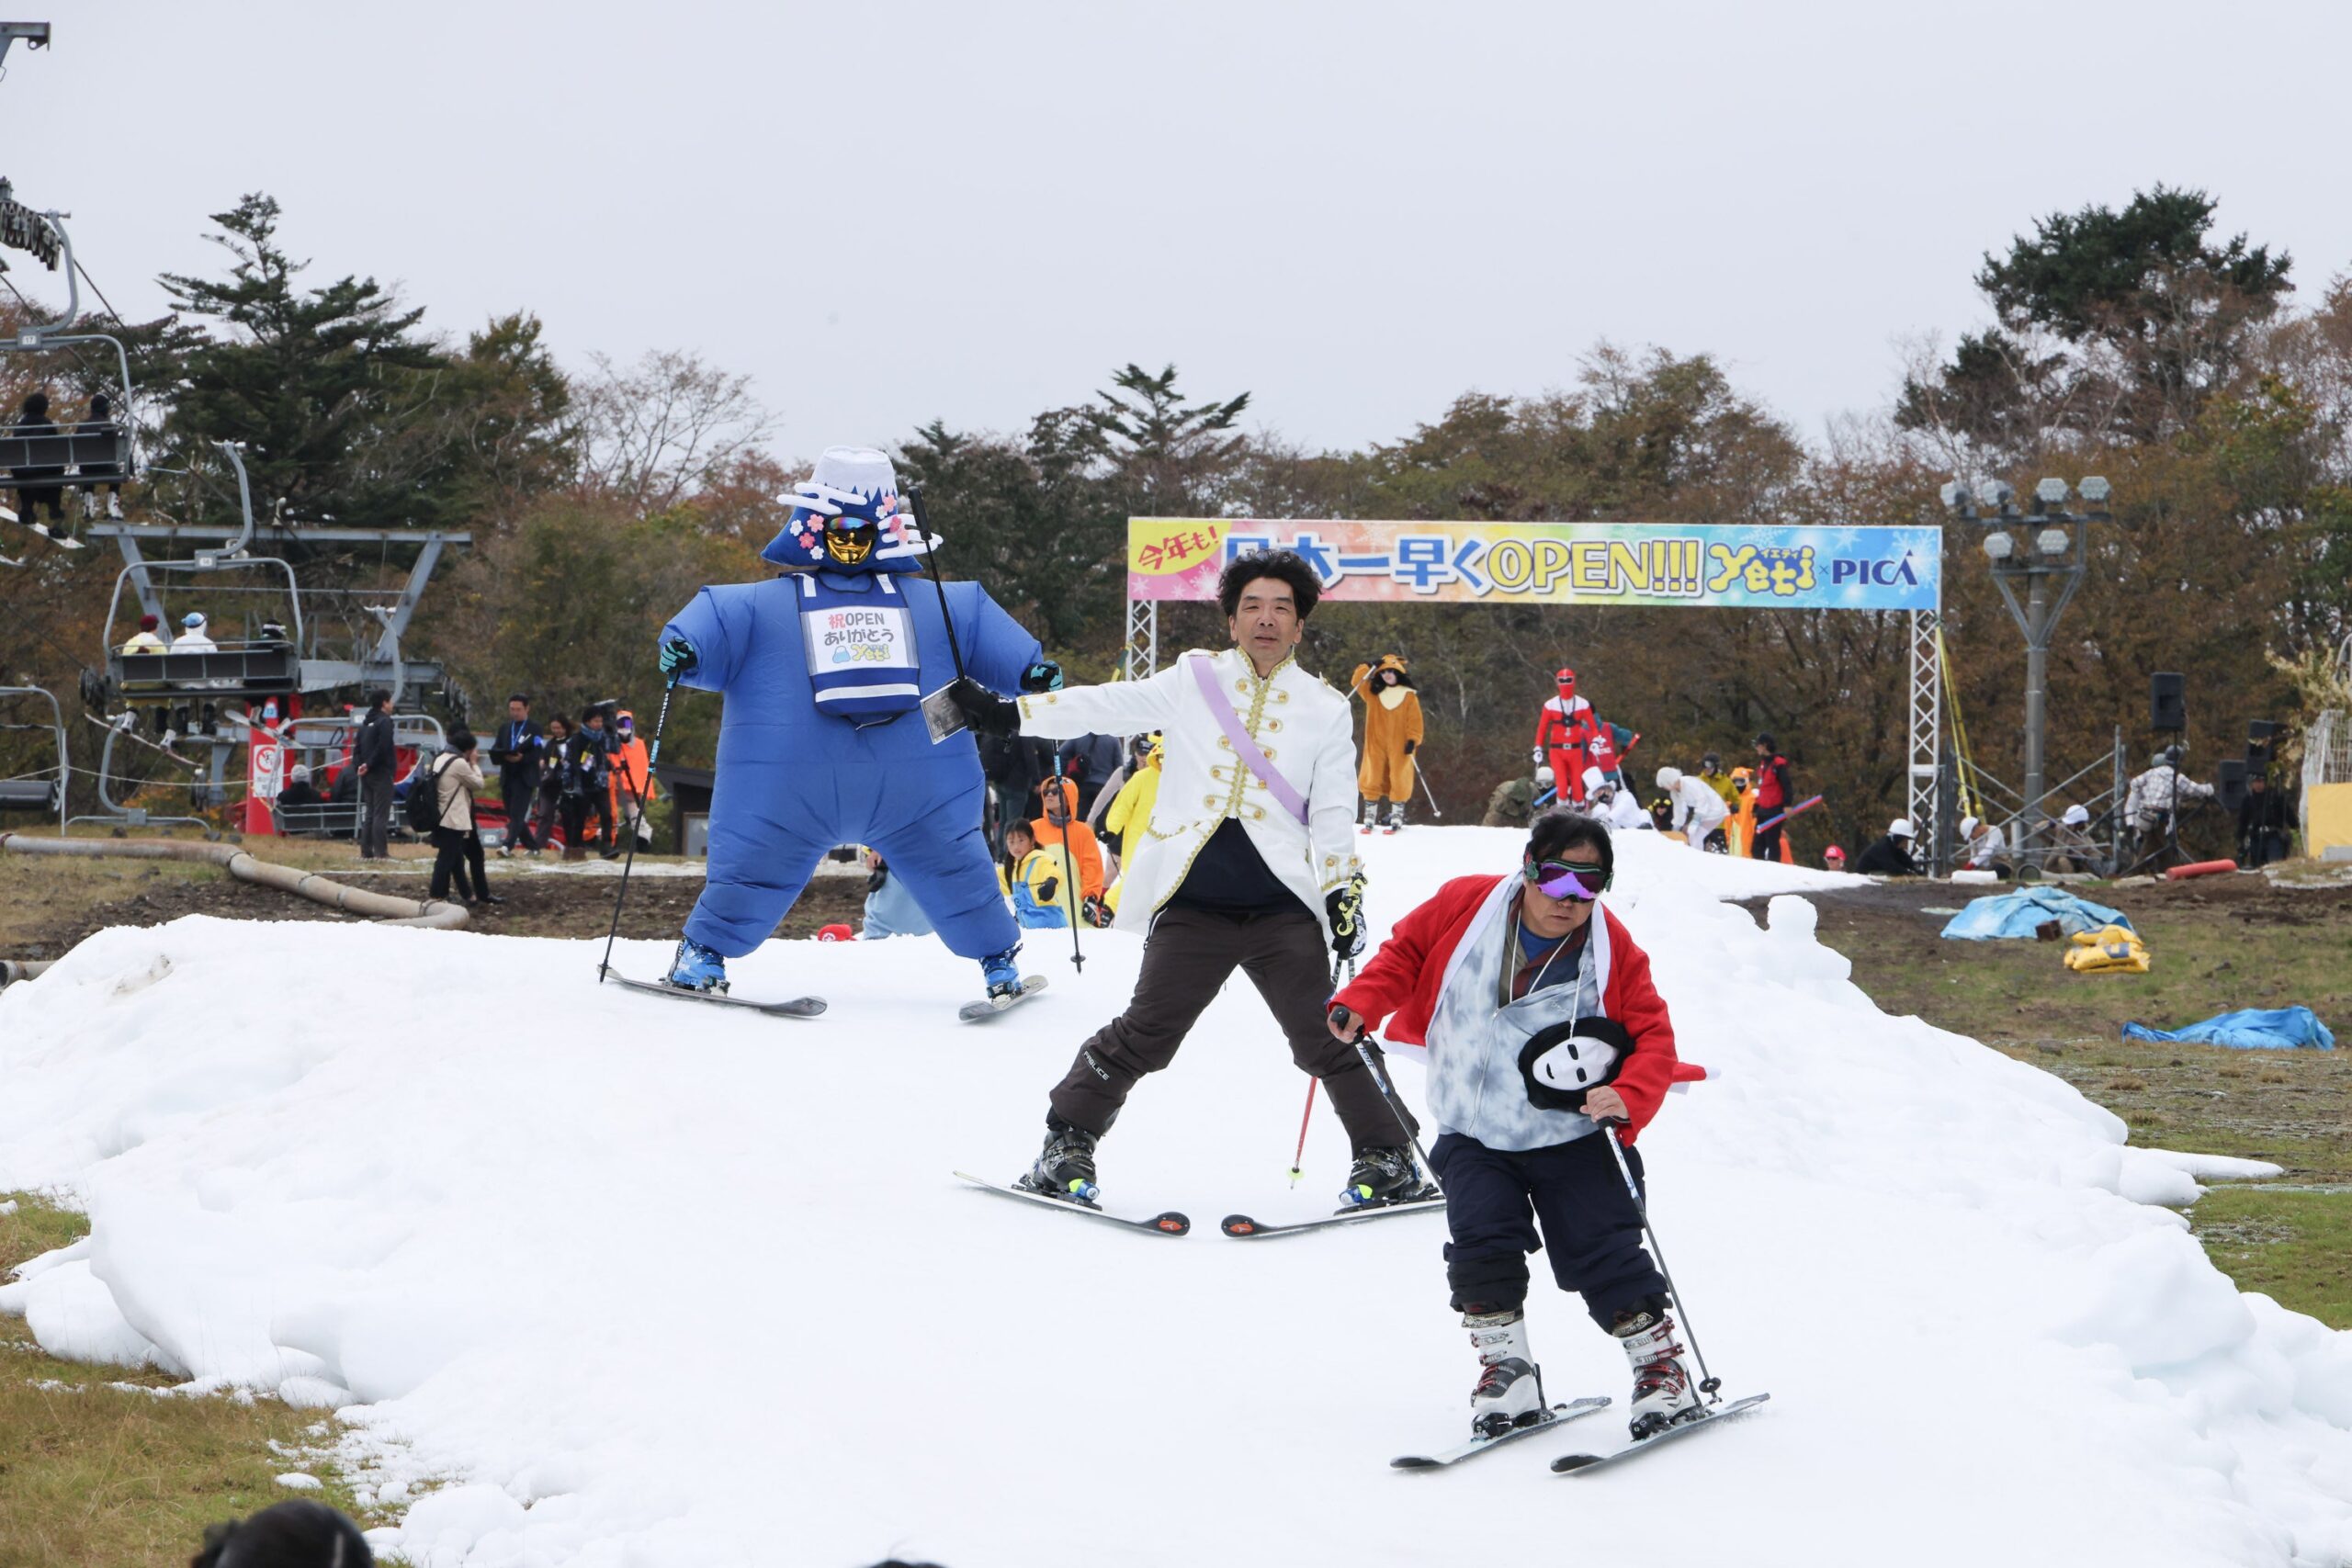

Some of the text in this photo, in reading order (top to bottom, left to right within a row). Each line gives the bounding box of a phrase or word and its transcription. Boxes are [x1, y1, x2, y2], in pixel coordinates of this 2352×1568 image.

[1137, 525, 1220, 570] 今年も!
[1831, 549, 1918, 586] PICA
[828, 612, 886, 629] 祝OPEN
[824, 628, 895, 647] ありがとう
